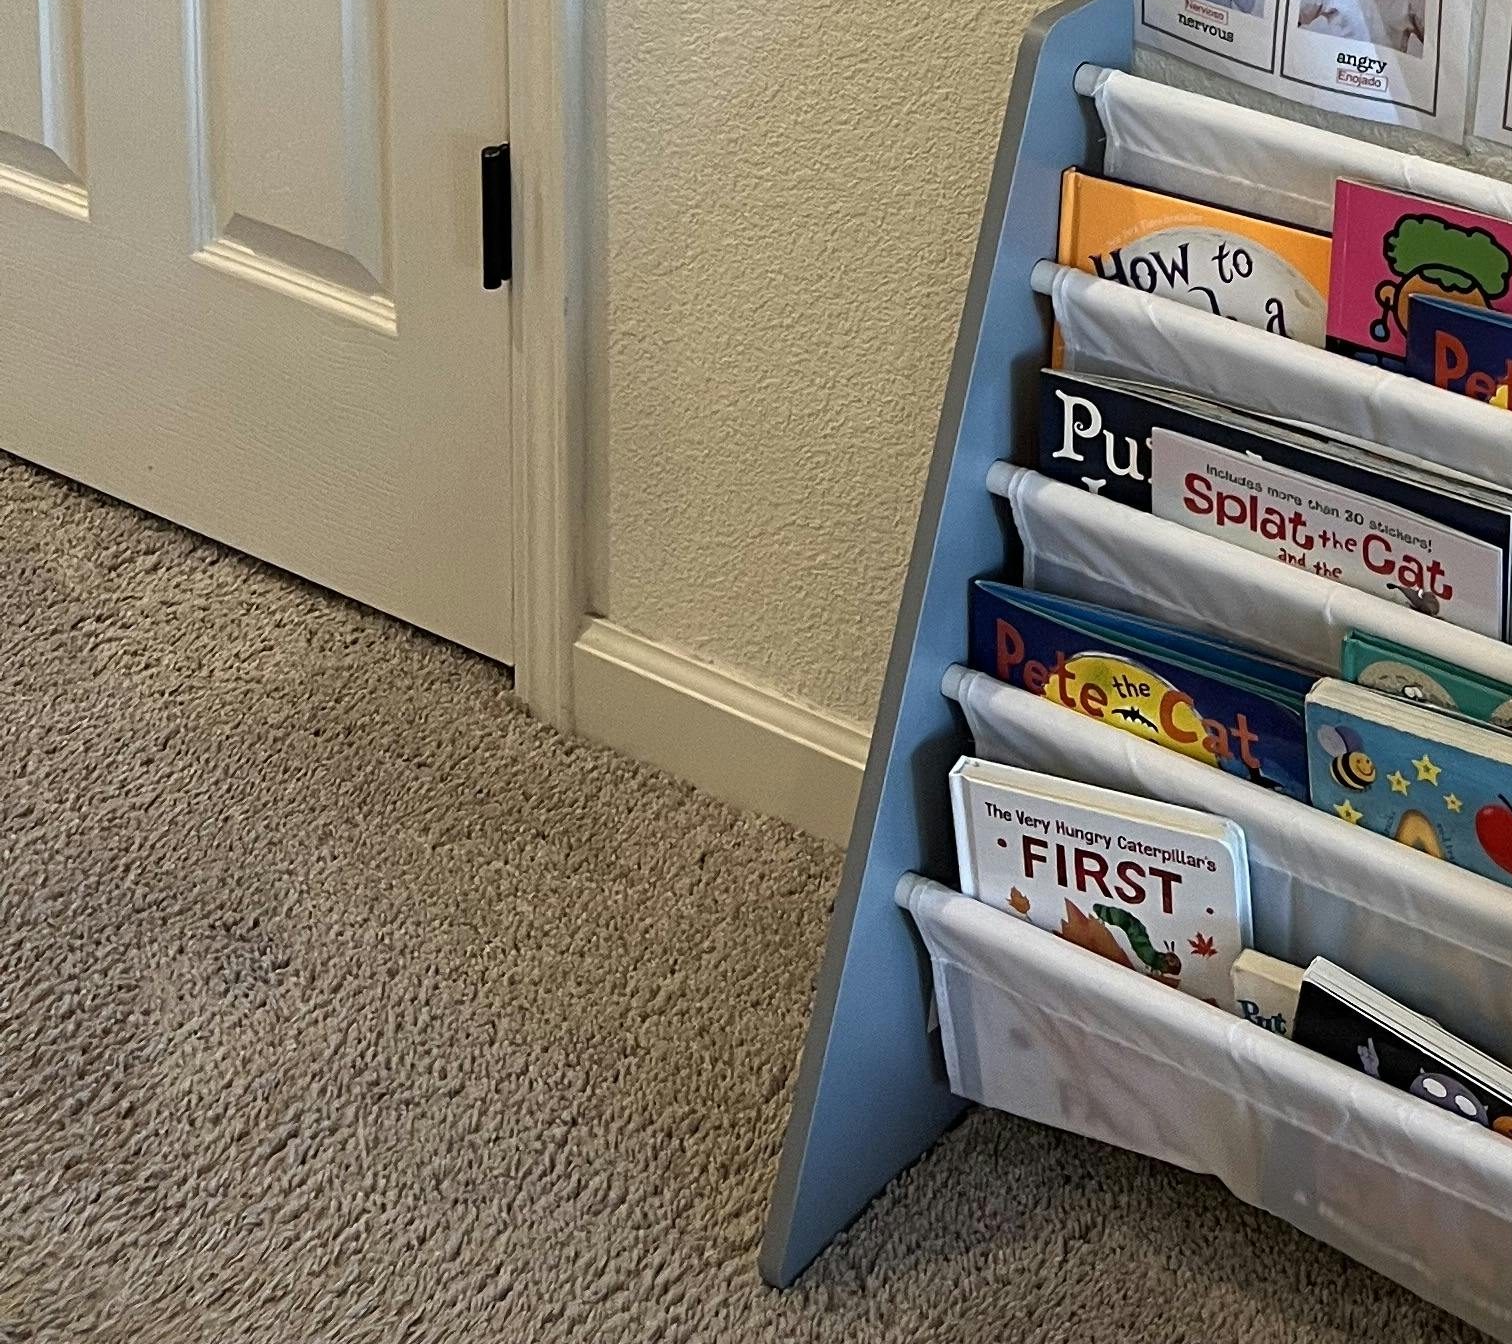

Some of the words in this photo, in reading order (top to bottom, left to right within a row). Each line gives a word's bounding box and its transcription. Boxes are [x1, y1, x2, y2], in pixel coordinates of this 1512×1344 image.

[1177, 12, 1234, 43] nervous
[1336, 50, 1387, 75] angry
[1337, 70, 1381, 89] Enojado
[1211, 240, 1253, 284] to
[1183, 472, 1315, 551] Splat
[1318, 529, 1358, 553] the
[1362, 533, 1454, 601] Cat
[1206, 463, 1263, 493] Includes
[1267, 485, 1303, 507] more
[1308, 499, 1340, 519] than
[1369, 519, 1433, 553] stickers!
[1278, 547, 1306, 569] and
[1312, 562, 1343, 580] the
[996, 618, 1109, 719] Pete
[1112, 674, 1151, 699] the
[1158, 689, 1261, 769] Cat
[984, 801, 1012, 823] The
[1016, 810, 1051, 834] Very
[1055, 820, 1112, 850] Hungry
[1117, 835, 1217, 873] Caterpillar's
[1022, 834, 1182, 915] FIRST
